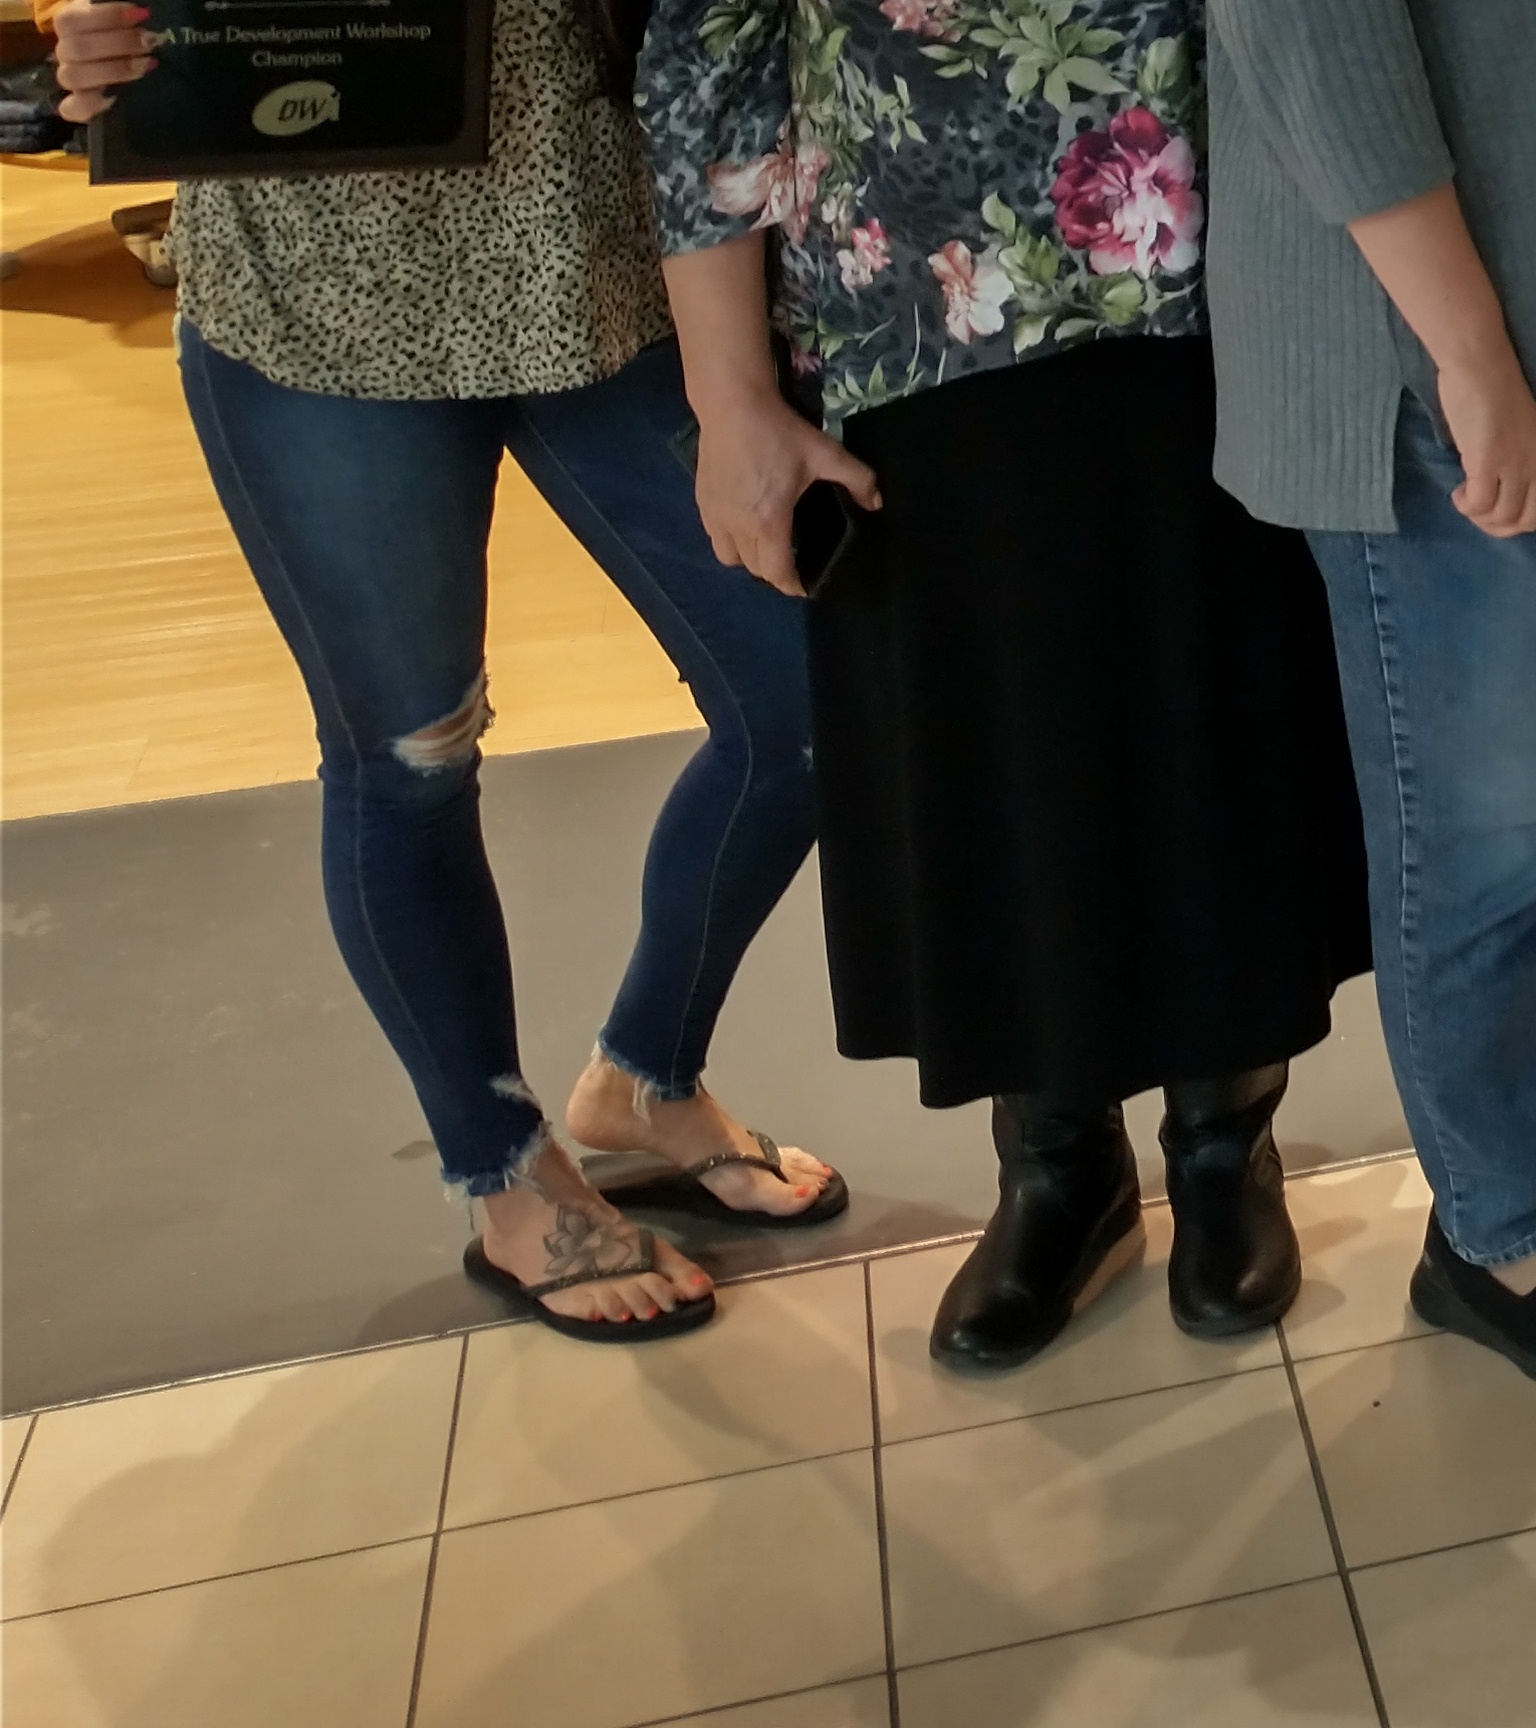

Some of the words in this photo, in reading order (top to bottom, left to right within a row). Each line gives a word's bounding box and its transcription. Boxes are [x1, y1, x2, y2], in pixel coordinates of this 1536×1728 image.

[179, 26, 221, 45] True
[226, 25, 342, 46] Development
[345, 22, 432, 42] Workshop
[251, 50, 343, 70] Champion
[278, 97, 328, 123] DW
